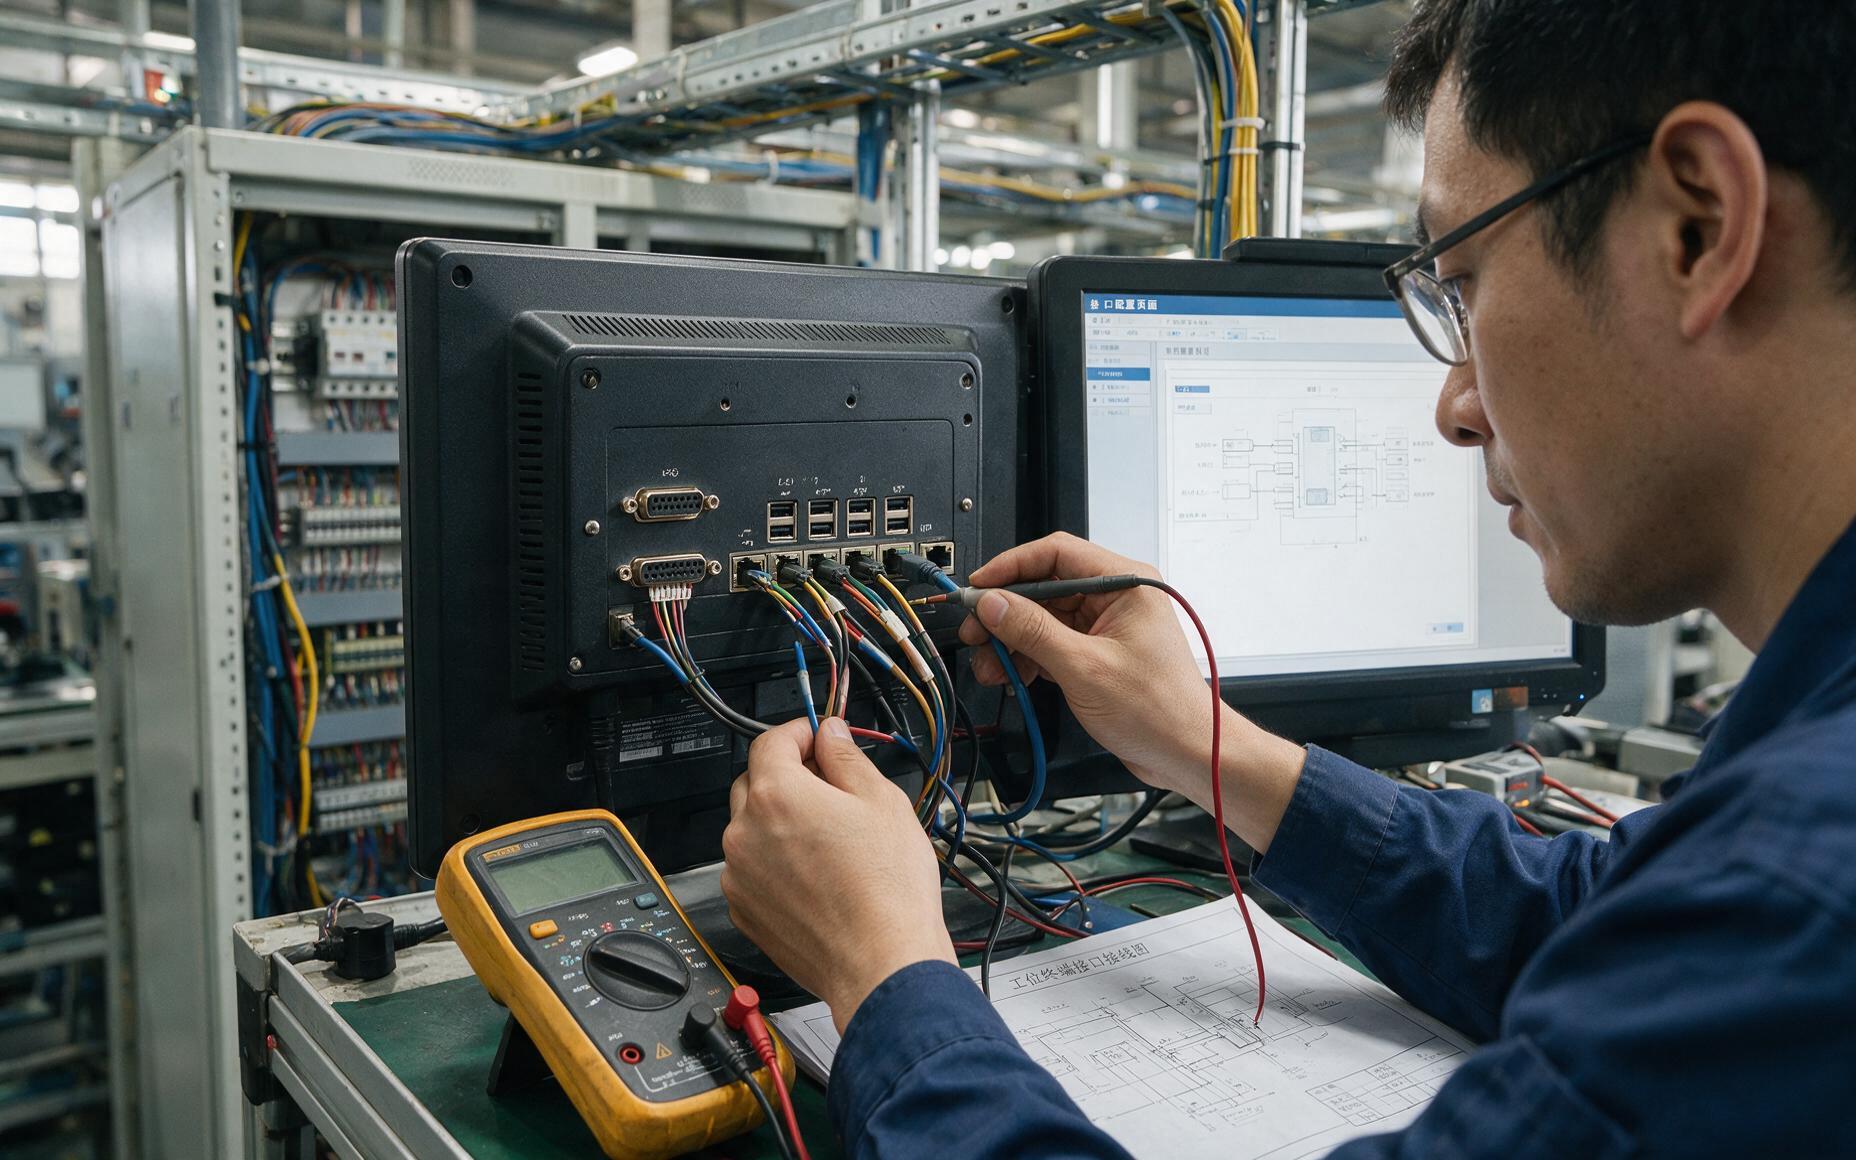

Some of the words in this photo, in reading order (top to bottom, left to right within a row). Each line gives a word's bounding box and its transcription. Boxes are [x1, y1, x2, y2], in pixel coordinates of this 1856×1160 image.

[1009, 942, 1150, 990] 工位终端接口接线图
